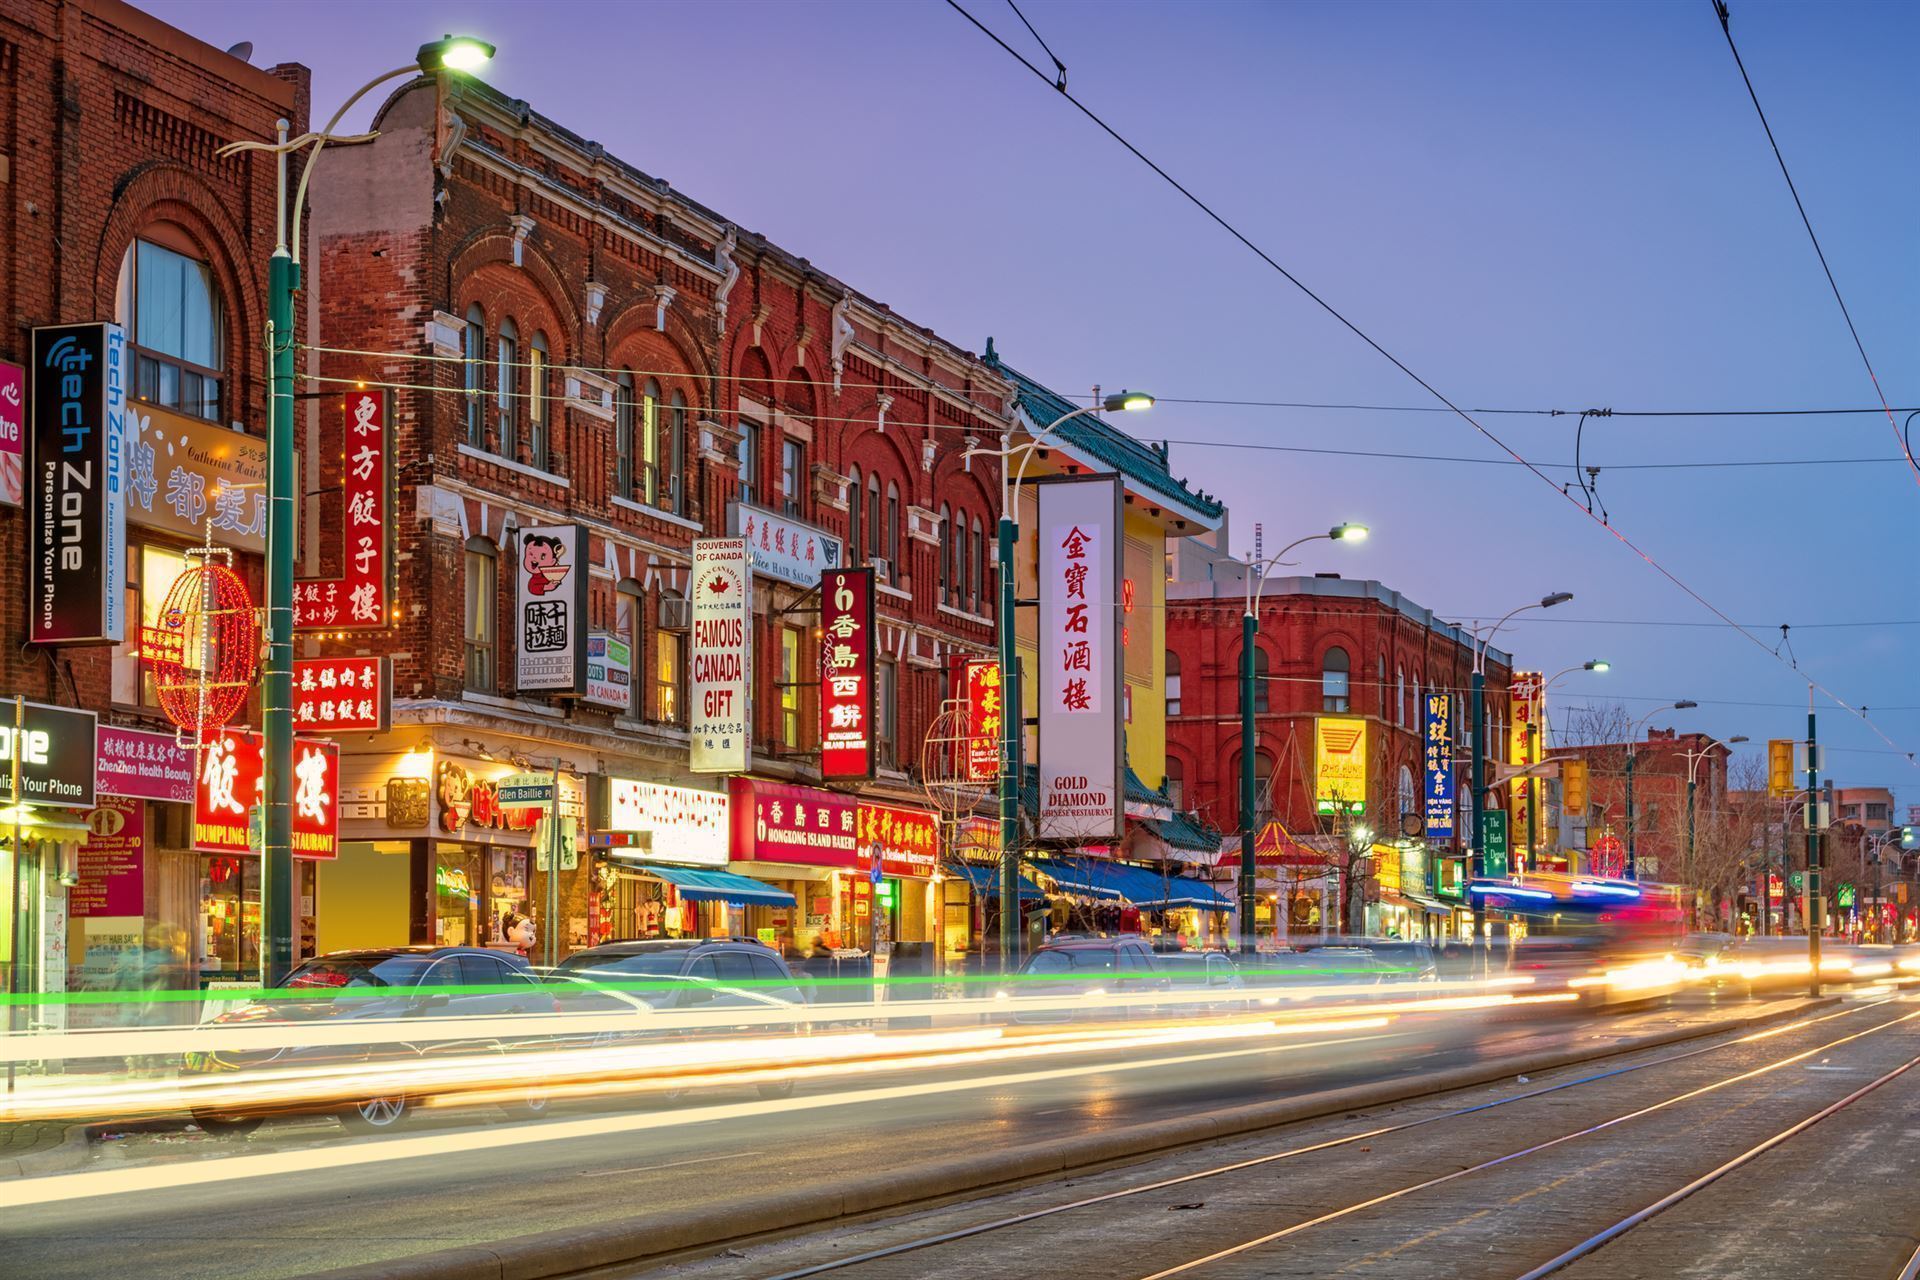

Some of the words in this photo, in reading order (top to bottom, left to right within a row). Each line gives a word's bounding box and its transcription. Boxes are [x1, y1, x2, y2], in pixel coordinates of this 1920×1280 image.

[109, 331, 124, 406] tech
[62, 348, 93, 452] tech
[108, 410, 123, 493] Zone
[44, 461, 57, 546] Personalize
[61, 460, 92, 571] Zone
[696, 540, 743, 550] SOUVENIRS
[696, 553, 707, 561] OF
[709, 552, 743, 561] CANADA
[44, 547, 56, 582] Your
[44, 584, 56, 630] Phone
[1061, 526, 1092, 712] 金寶石酒樓
[695, 618, 743, 648] FAMOUS
[694, 653, 742, 683] CANADA
[597, 685, 622, 702] CANADA
[704, 689, 733, 718] GIFT
[98, 757, 137, 775] ZhenZhen
[139, 762, 163, 778] Health
[164, 766, 192, 785] Beauty
[1054, 776, 1088, 790] GOLD
[22, 776, 47, 792] Your
[49, 779, 83, 796] Phone
[499, 789, 517, 800] Glen
[517, 788, 543, 799] Baillie
[1048, 792, 1106, 807] DIAMOND
[1071, 808, 1113, 817] RESTAURANT
[195, 823, 245, 846] DUMPLING
[1490, 817, 1500, 828] The
[768, 827, 807, 846] HONGKONG
[807, 831, 831, 848] ISLAND
[832, 834, 857, 851] BAKERY
[1490, 833, 1503, 844] Herb
